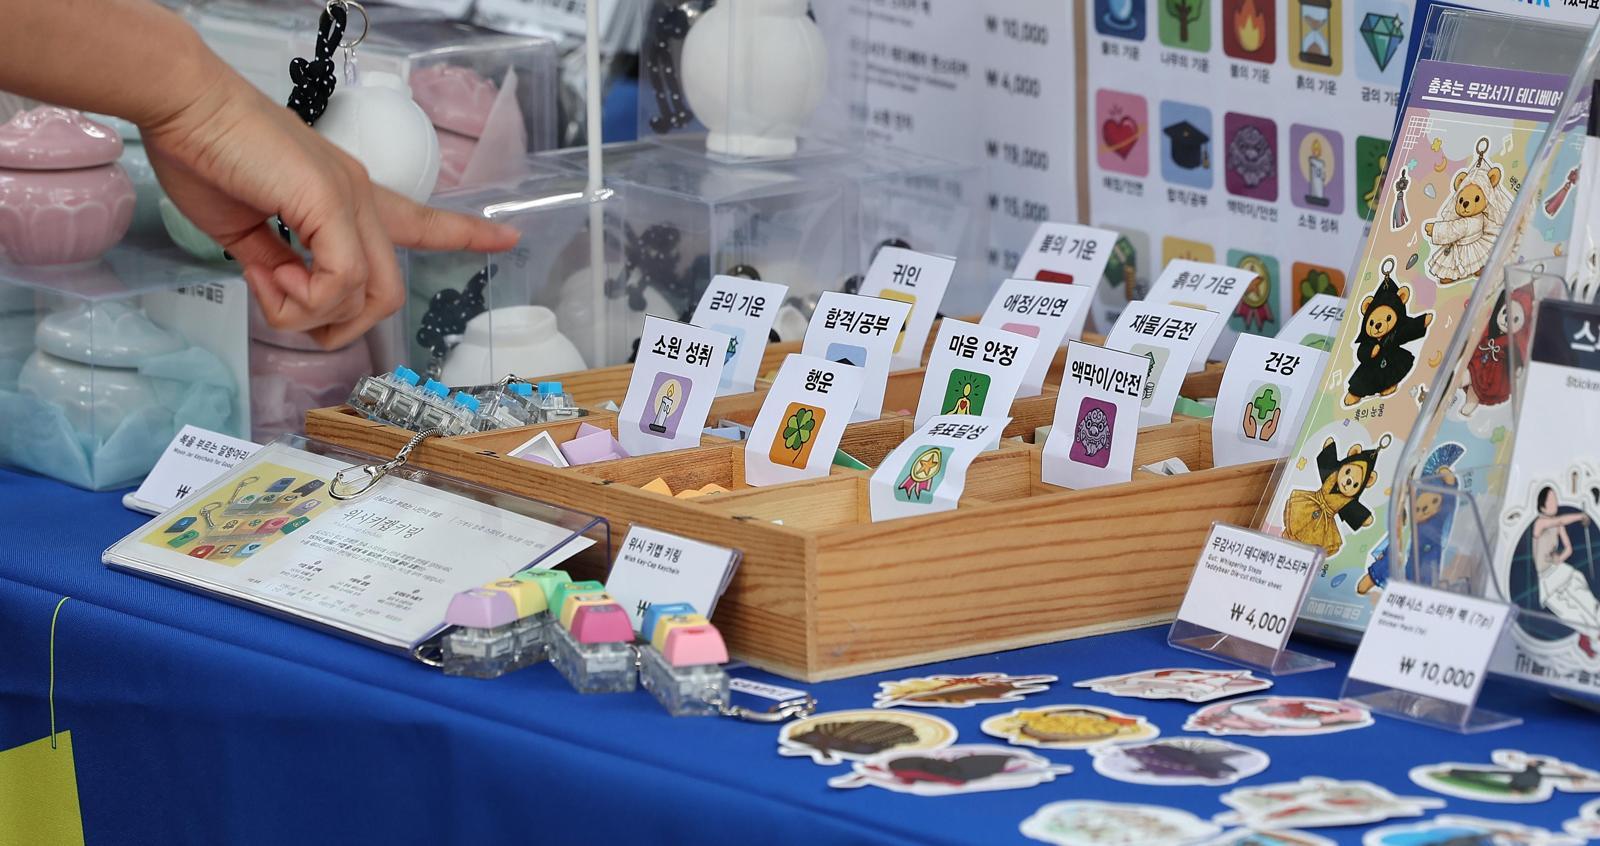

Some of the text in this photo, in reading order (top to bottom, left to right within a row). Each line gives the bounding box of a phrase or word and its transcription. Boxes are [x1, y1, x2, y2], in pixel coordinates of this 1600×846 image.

[1002, 18, 1049, 46] 10,000
[1122, 45, 1140, 61] 기운
[1160, 52, 1210, 73] 나무의 기운
[1001, 73, 1041, 98] 4,000
[1230, 63, 1271, 83] 불의 기운
[1317, 79, 1337, 95] 기운
[1362, 86, 1380, 103] 금의
[1428, 77, 1565, 107] 춤추는 무감서기 테디베어
[1297, 213, 1339, 233] 소원 성취
[1038, 234, 1097, 261] 불의 기운
[892, 263, 922, 288] 귀인
[1171, 270, 1237, 296] 흙의 기운
[709, 290, 766, 318] 금의 기운
[1003, 293, 1070, 318] 애정/인연
[824, 307, 891, 337] 합격/공부
[1128, 313, 1198, 342] 재물/금전
[1570, 320, 1600, 352] 스
[652, 334, 714, 368] 소원 성취
[948, 334, 1019, 367] 마음 안정
[1264, 351, 1301, 377] 건강
[804, 368, 835, 394] 행운
[1071, 360, 1143, 398] 액막이/안전
[928, 422, 988, 441] 목표달성
[179, 434, 250, 461] 복을 부르는 달항아리
[343, 508, 425, 539] 위시키캡키링
[628, 536, 683, 564] 위시 키캡 키링
[1212, 536, 1310, 577] 무감서기 테디베어 판스티커
[657, 562, 680, 575] Keychain
[1205, 561, 1230, 575] Teddybear
[1230, 569, 1249, 580] Die-cut
[1249, 575, 1267, 586] sticker
[1245, 608, 1287, 634] 4,000
[1425, 603, 1456, 621] 스티커
[1420, 660, 1476, 690] 10,000
